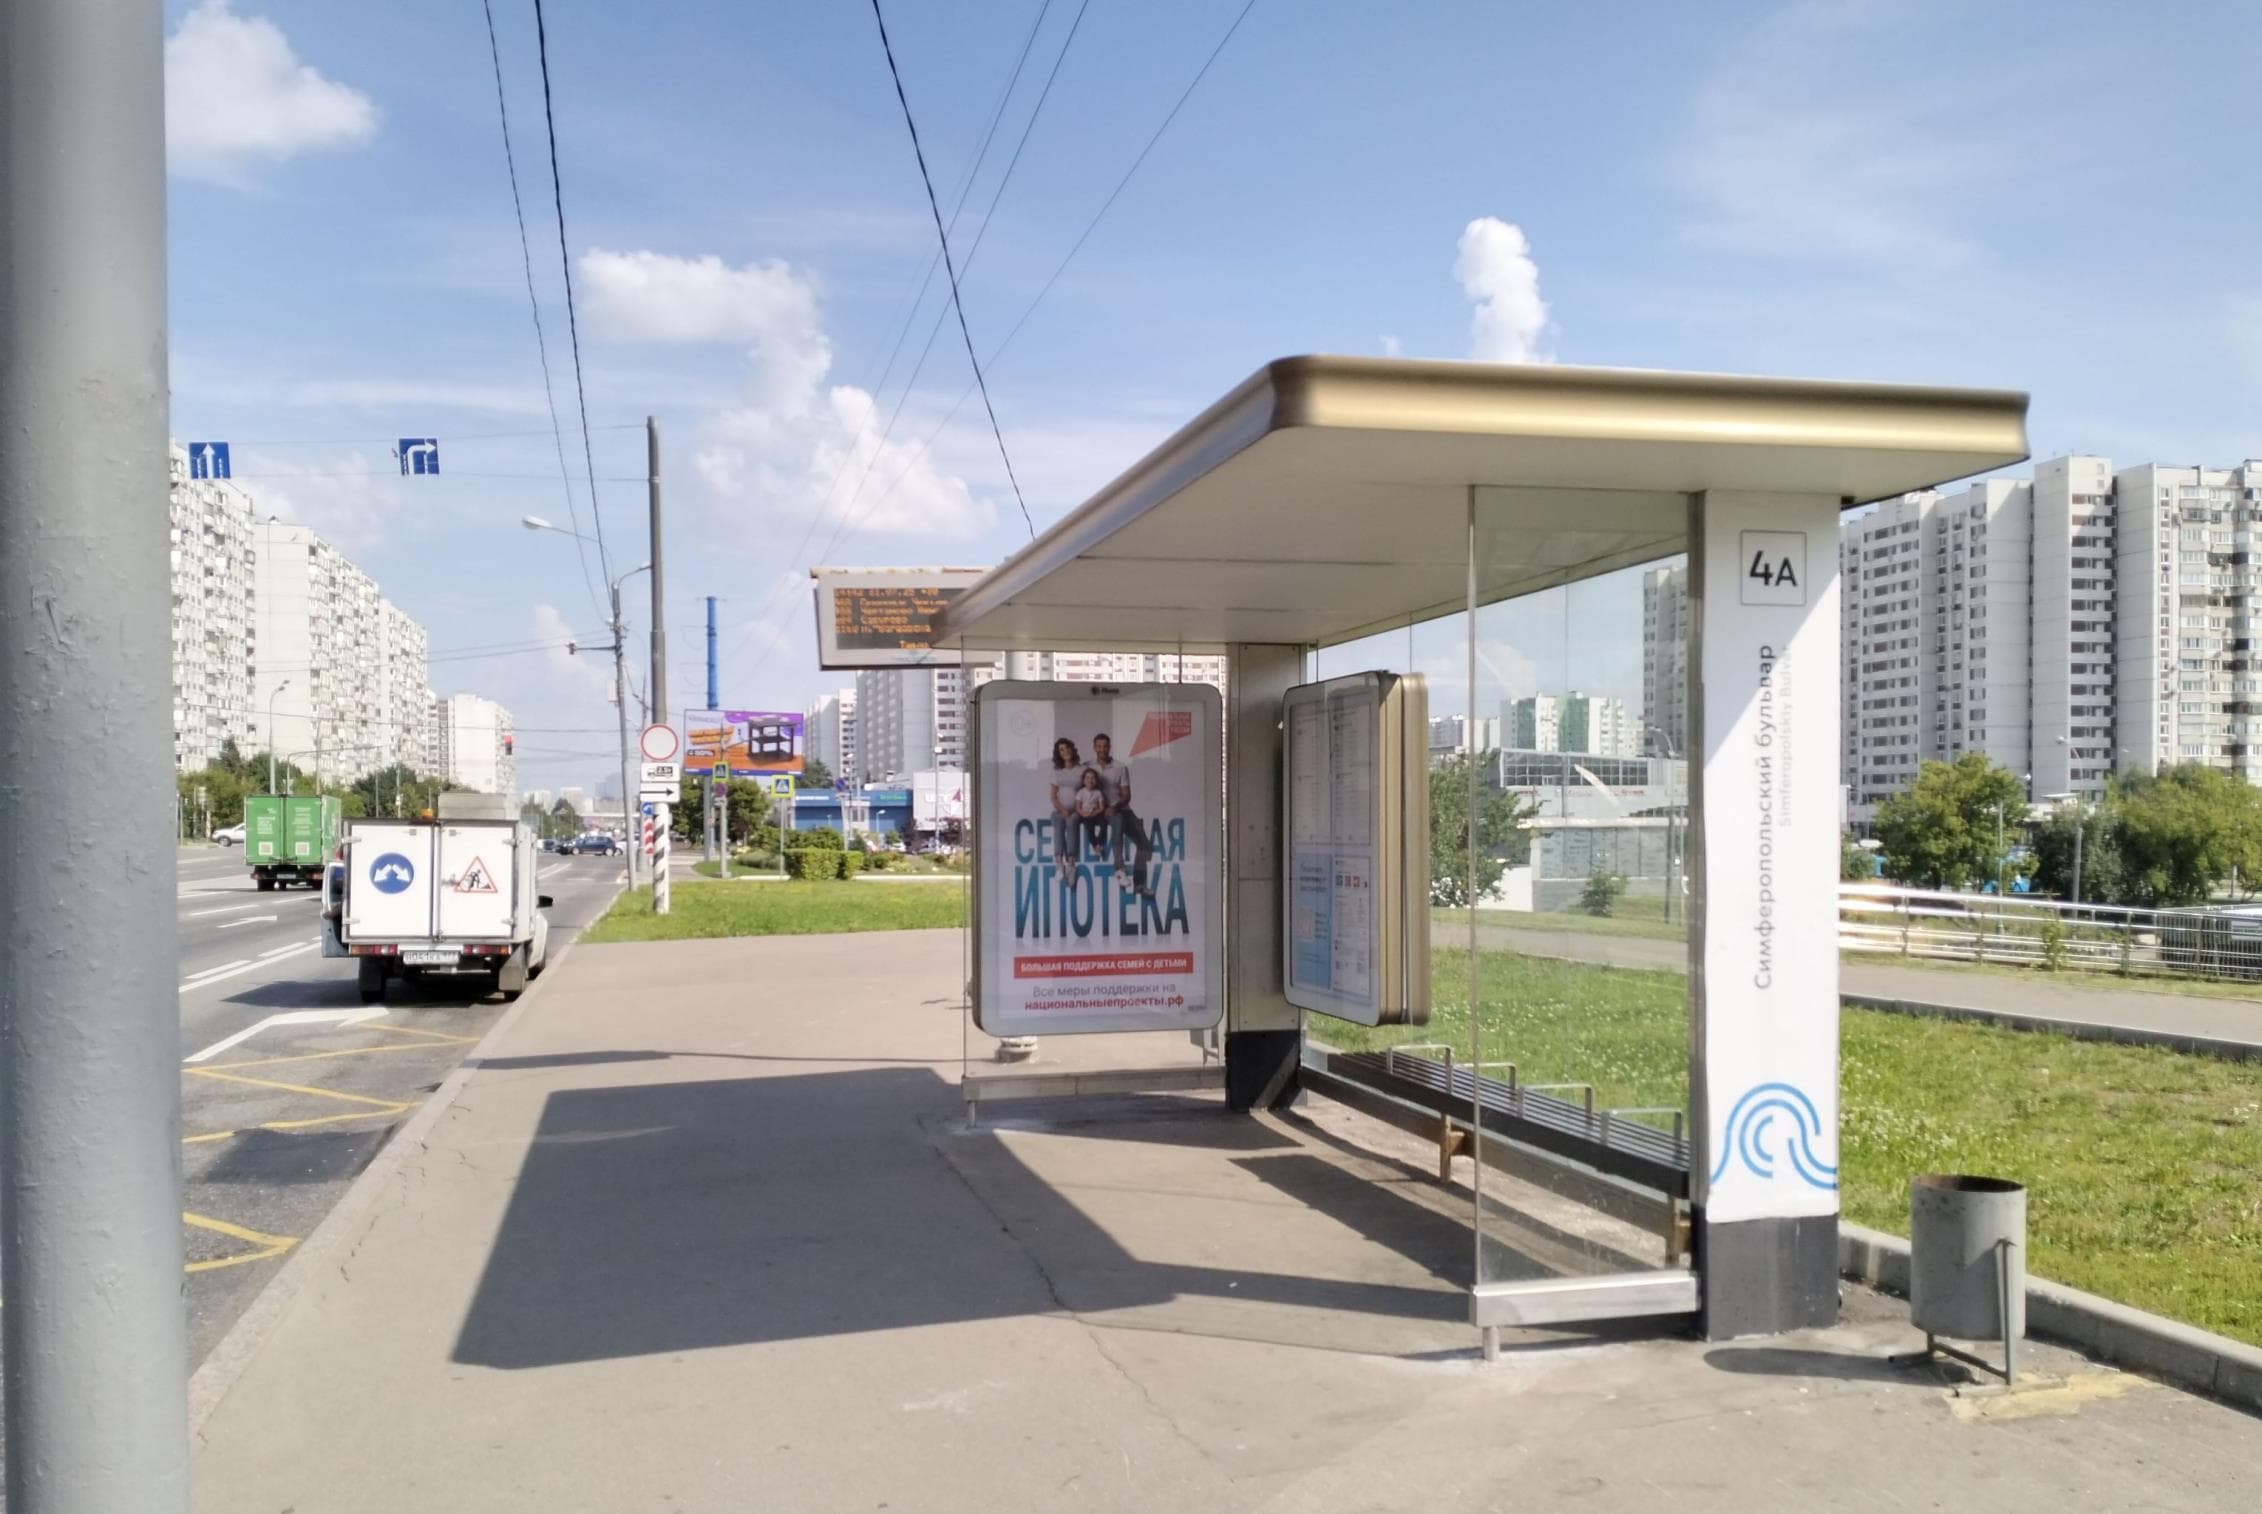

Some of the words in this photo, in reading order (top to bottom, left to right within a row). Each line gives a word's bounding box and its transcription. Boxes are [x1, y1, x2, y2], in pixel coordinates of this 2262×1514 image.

[1753, 645, 1777, 748] бульвар
[1778, 702, 1793, 828] Simferopolskiy
[1015, 863, 1190, 938] ИПОТЕКА
[1753, 756, 1776, 990] Симферопольский
[1033, 985, 1055, 998] Все
[1057, 986, 1091, 998] меры
[1093, 983, 1160, 997] поддержки
[1162, 983, 1177, 993] на
[1117, 958, 1145, 969] СЕМЕЙ
[1024, 994, 1185, 1011] национальныепроекты.рф
